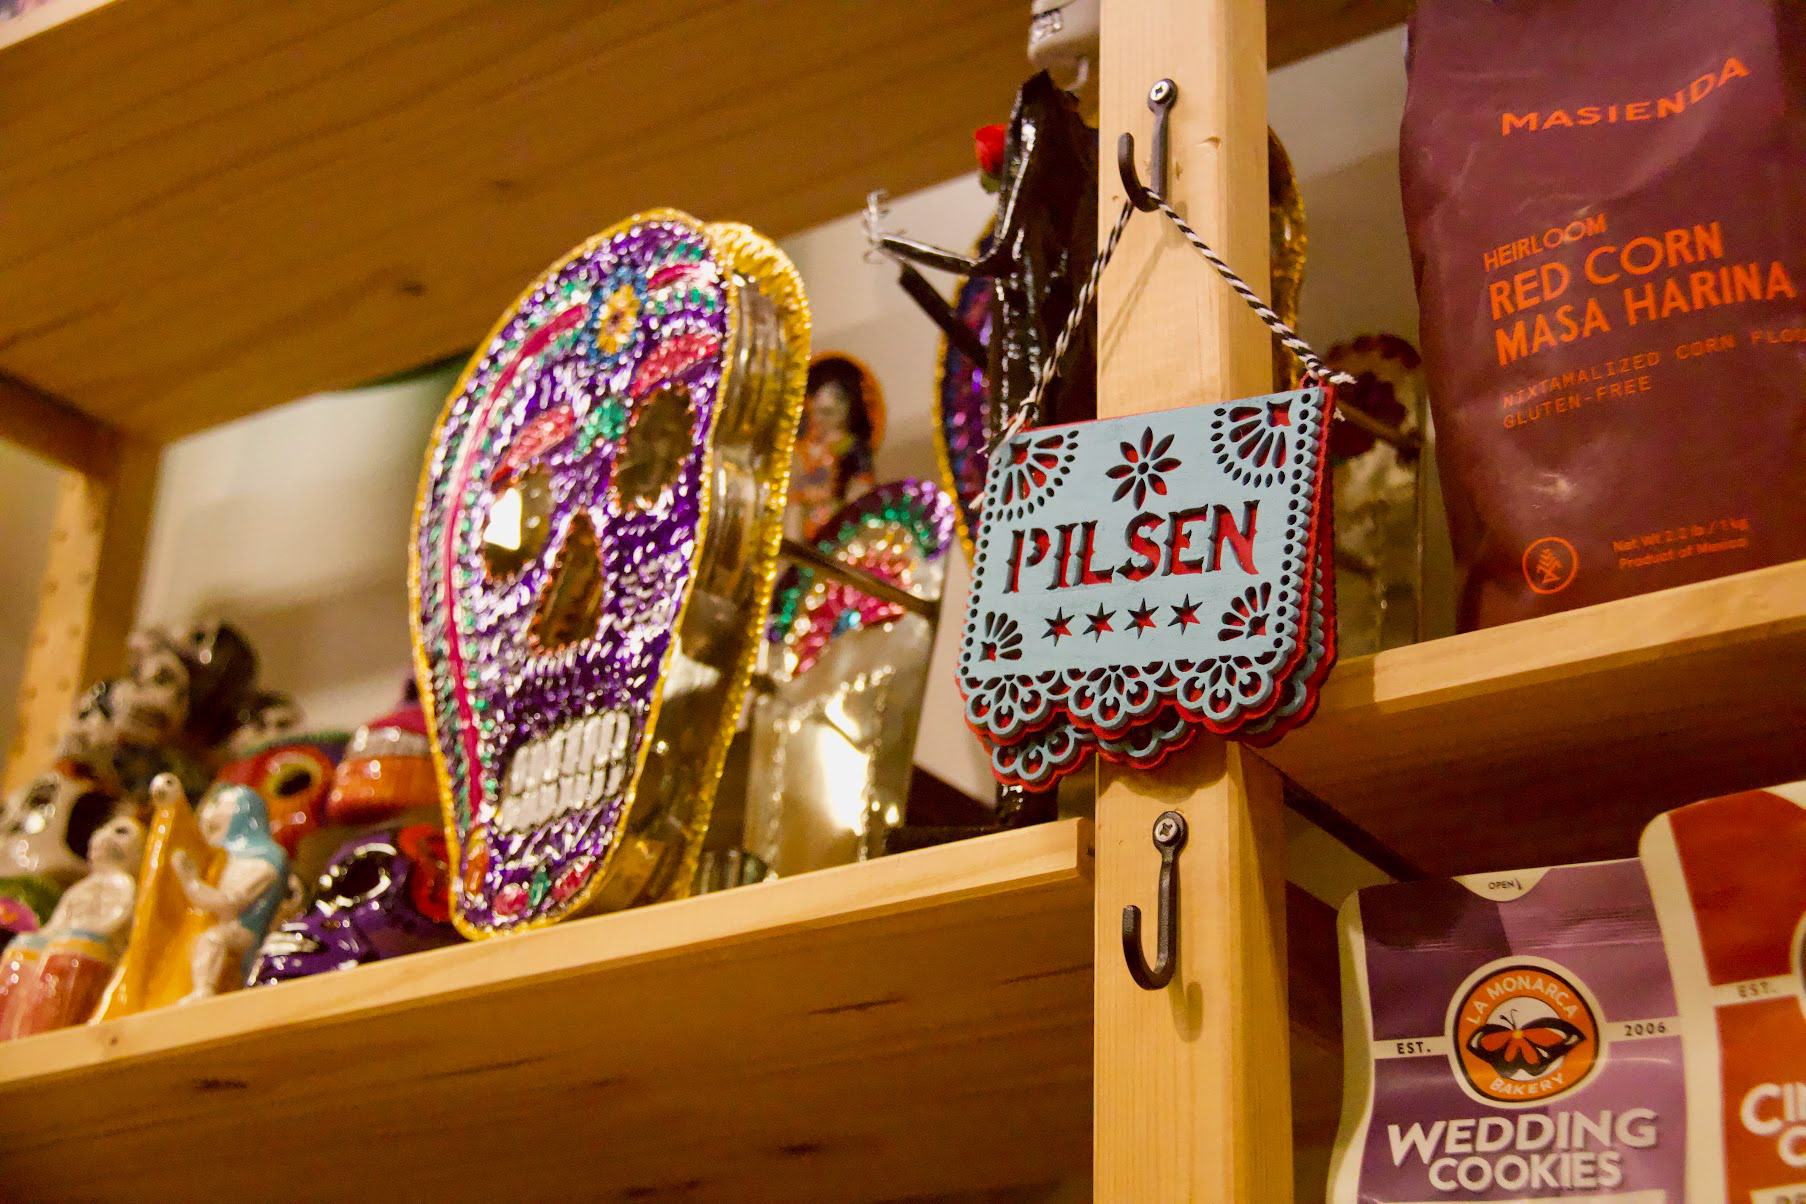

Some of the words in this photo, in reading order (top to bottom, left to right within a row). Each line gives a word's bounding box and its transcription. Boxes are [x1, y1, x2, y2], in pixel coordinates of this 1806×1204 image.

[1502, 56, 1750, 136] MASIENDA
[1483, 213, 1607, 273] HEIRLOOM
[1489, 262, 1571, 320] RED
[1584, 222, 1723, 286] CORN
[1495, 298, 1611, 367] MASA
[1624, 260, 1797, 326] HARINA
[1503, 351, 1662, 409] NIXTAMALIZED
[1676, 335, 1737, 360] CORN
[1503, 375, 1652, 429] GLUTEN-FREE
[1002, 500, 1260, 594] PILSEN
[1487, 880, 1515, 890] OPEN
[1466, 1000, 1489, 1025] LA
[1485, 975, 1579, 1019] MONARCA
[1737, 983, 1776, 999] EST.
[1396, 1041, 1432, 1055] EST.
[1623, 1021, 1667, 1037] 2006
[1489, 1073, 1565, 1096] BAKERY
[1387, 1107, 1659, 1168] WEDDING
[1429, 1151, 1625, 1193] COOKIES
